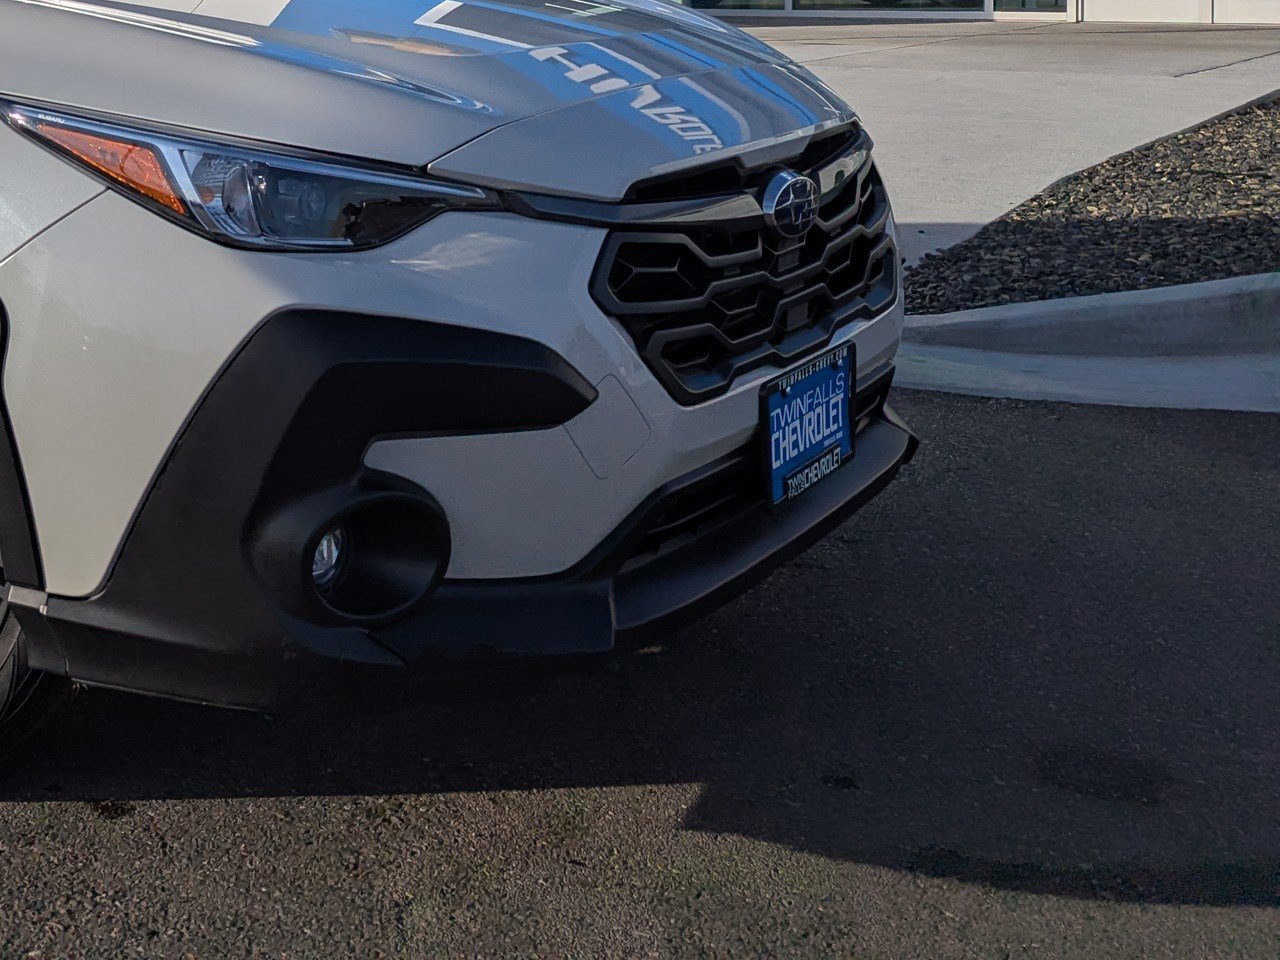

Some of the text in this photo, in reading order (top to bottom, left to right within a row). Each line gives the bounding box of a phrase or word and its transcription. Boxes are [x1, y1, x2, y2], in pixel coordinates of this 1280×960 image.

[771, 372, 845, 431] TWINFALLS
[771, 393, 844, 470] CHEVROLET
[804, 448, 841, 488] CHEVROLET
